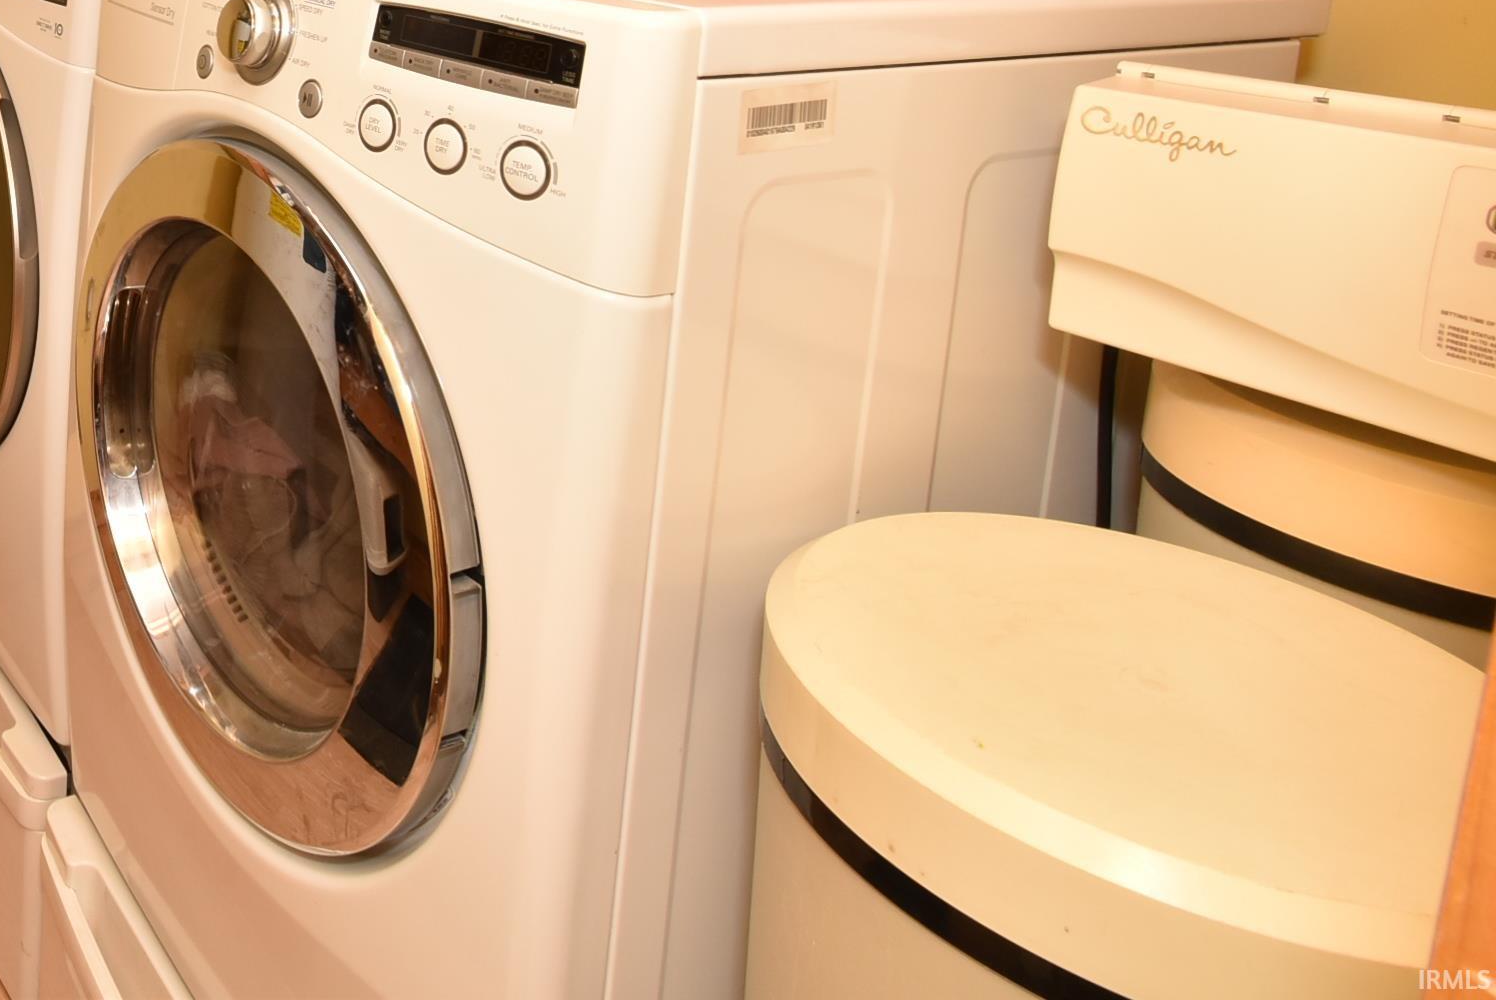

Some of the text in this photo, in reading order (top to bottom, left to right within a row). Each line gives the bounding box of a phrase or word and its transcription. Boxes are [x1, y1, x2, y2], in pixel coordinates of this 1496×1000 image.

[365, 123, 382, 134] LEVEL
[1080, 105, 1238, 162] Culligan
[435, 137, 451, 147] TIME
[512, 160, 532, 171] TEMP
[504, 166, 539, 183] CONTROL
[1448, 325, 1469, 334] PRESS
[1447, 331, 1468, 341] PRESS
[1446, 338, 1467, 348] PRESS
[1445, 345, 1467, 354] PRESS
